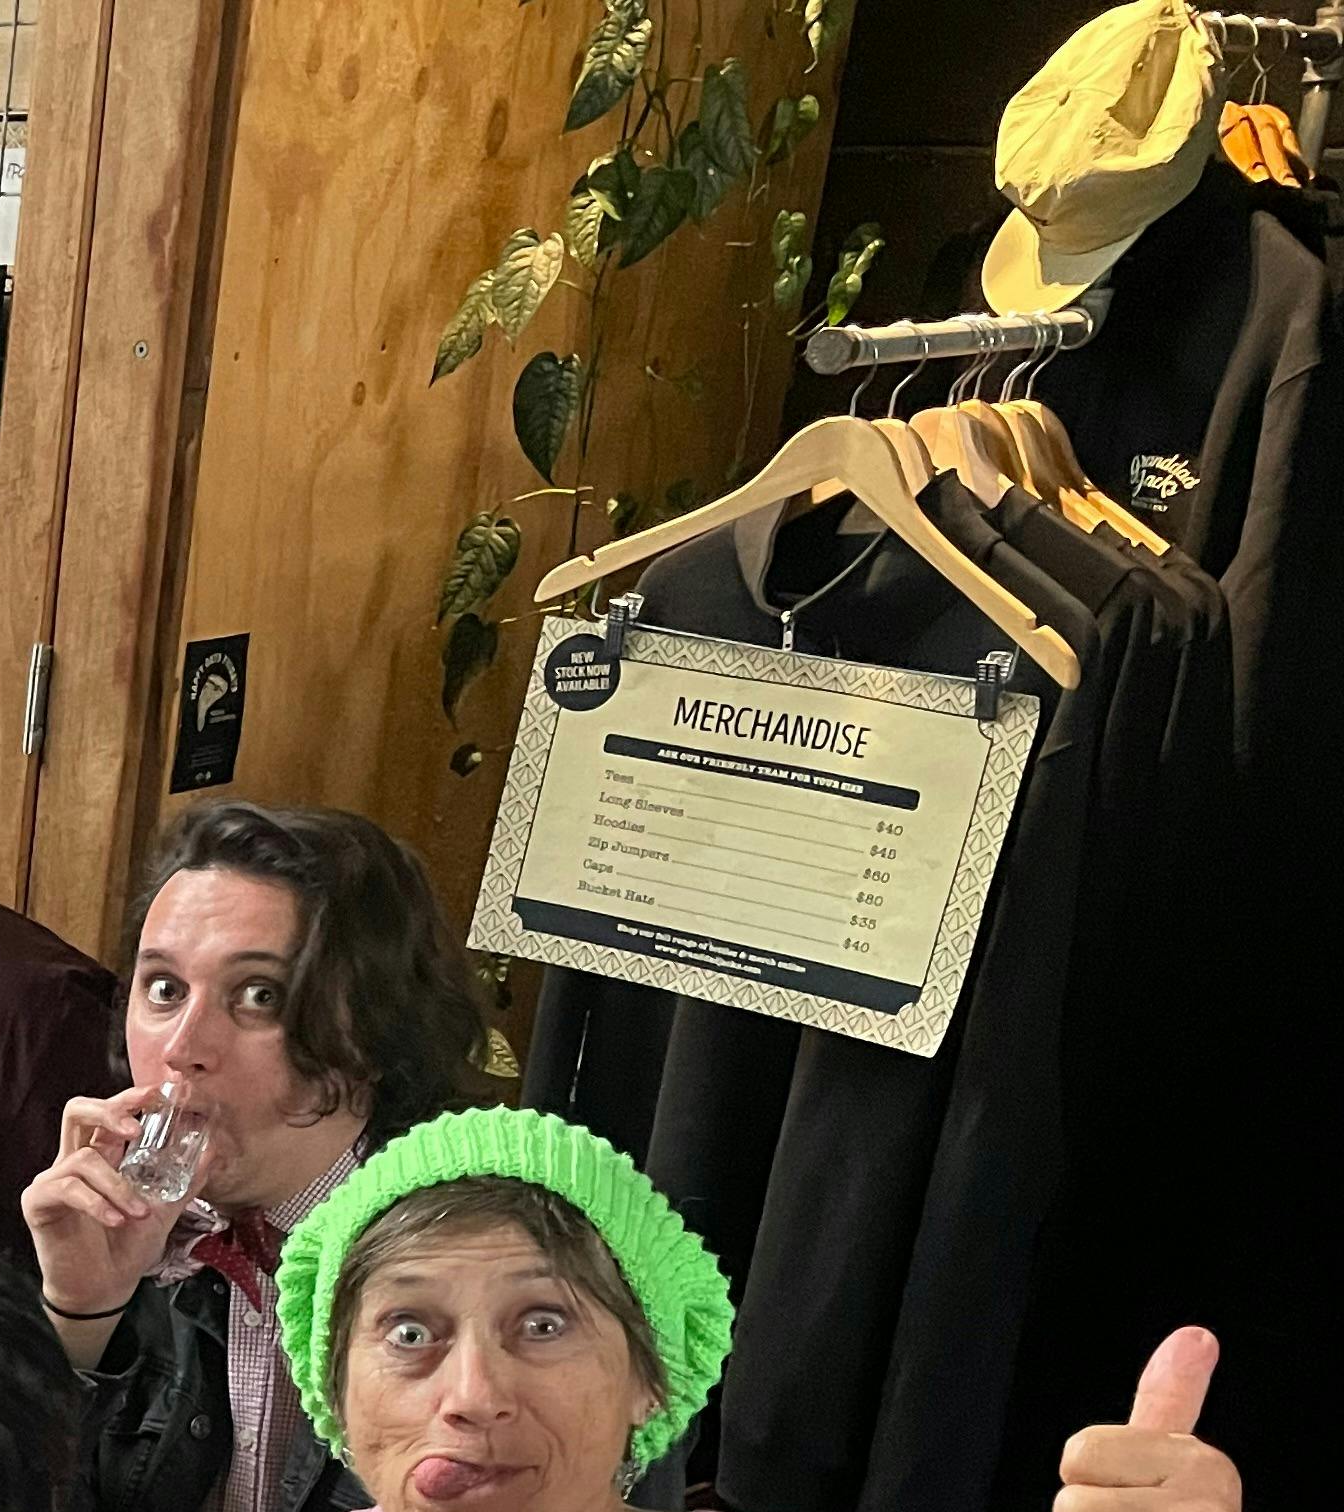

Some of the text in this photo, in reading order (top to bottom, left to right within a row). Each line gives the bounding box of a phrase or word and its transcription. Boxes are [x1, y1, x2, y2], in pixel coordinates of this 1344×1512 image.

[555, 664, 611, 679] STOCK NOW
[571, 651, 595, 664] NEW
[673, 696, 872, 758] MERCHANDISE
[658, 749, 678, 760] ASK
[679, 754, 701, 764] OUR
[703, 758, 756, 773] FRIENDLY
[758, 766, 789, 779] TEAM
[599, 791, 633, 809] Long
[635, 800, 685, 817] Sleeves
[593, 814, 891, 884] Hoodies $60
[875, 820, 904, 836] $40
[583, 859, 877, 930] Caps $35
[588, 836, 884, 907] Zip Jumpers $80
[577, 880, 870, 953] Bucket Hats $40
